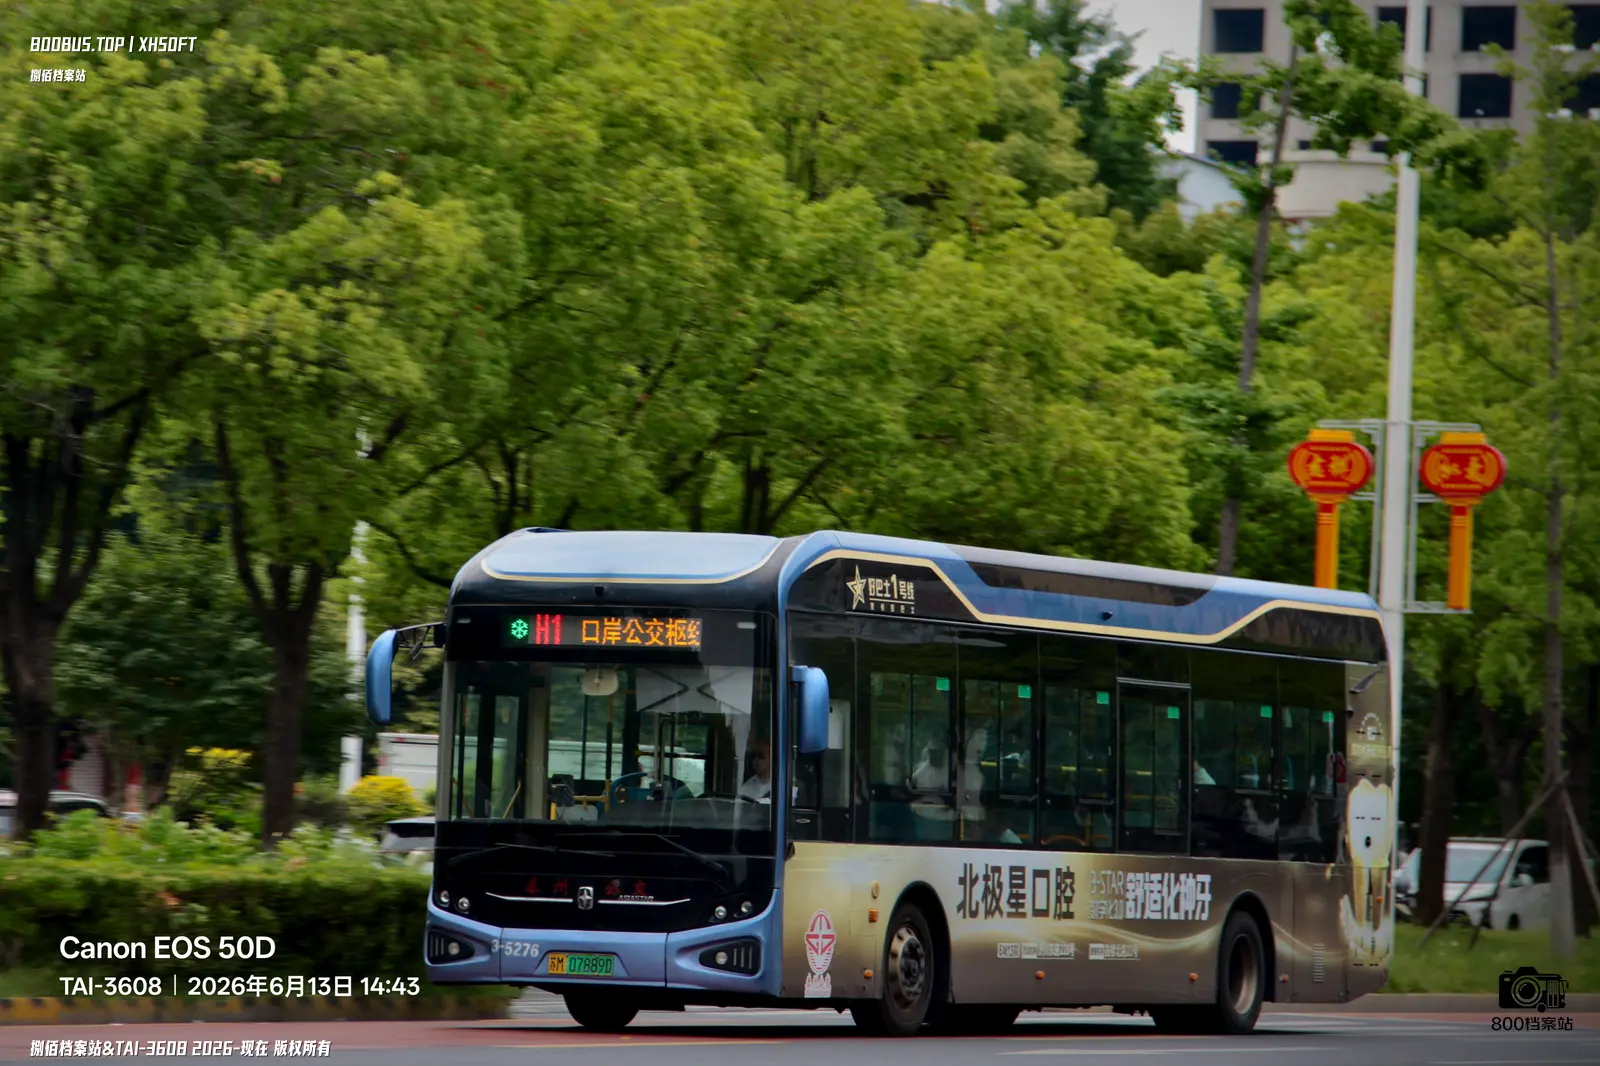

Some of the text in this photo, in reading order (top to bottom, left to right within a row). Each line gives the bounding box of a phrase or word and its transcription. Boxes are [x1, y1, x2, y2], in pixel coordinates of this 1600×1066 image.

[535, 614, 562, 645] H1
[956, 863, 1076, 920] 北极星口腔
[491, 939, 539, 957] 3-5276
